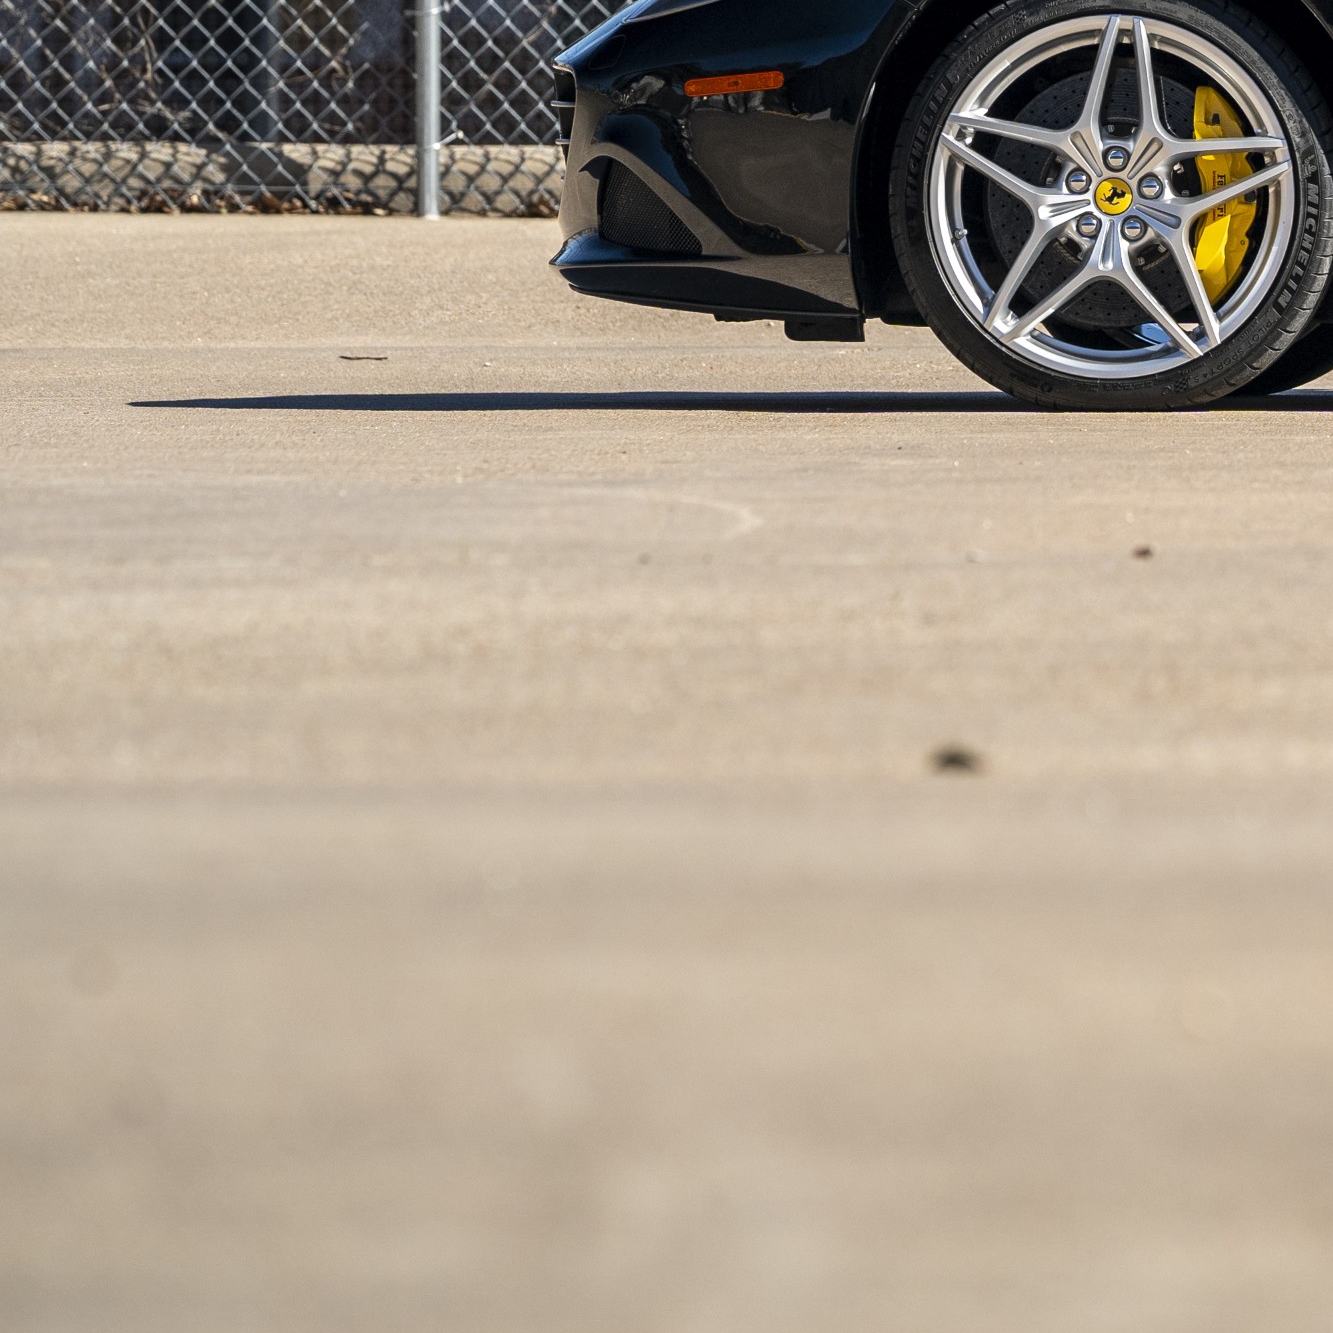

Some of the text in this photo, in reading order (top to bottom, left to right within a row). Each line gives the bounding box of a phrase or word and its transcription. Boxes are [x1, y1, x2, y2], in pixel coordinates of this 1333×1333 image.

[906, 82, 948, 209] MICHELIN
[1217, 174, 1226, 217] Feri
[1277, 182, 1320, 309] MICHELIN
[1247, 320, 1273, 346] PILOT
[1210, 348, 1244, 375] SPORT
